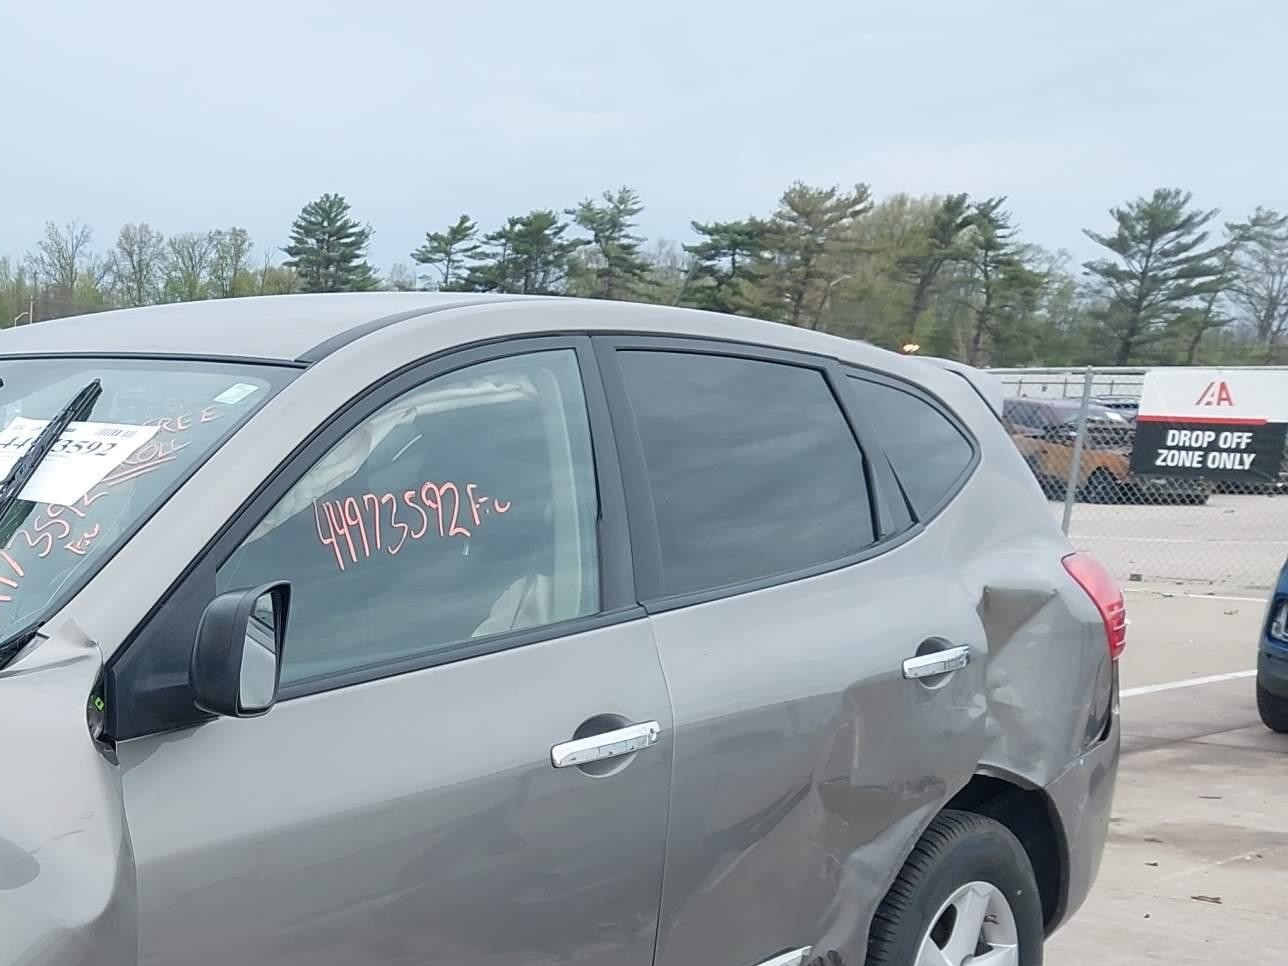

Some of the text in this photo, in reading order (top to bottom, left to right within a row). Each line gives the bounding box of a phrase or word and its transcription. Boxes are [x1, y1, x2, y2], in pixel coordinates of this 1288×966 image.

[0, 436, 118, 456] 443592
[1166, 430, 1253, 449] DROP OFF
[1155, 450, 1256, 471] ZONE ONLY
